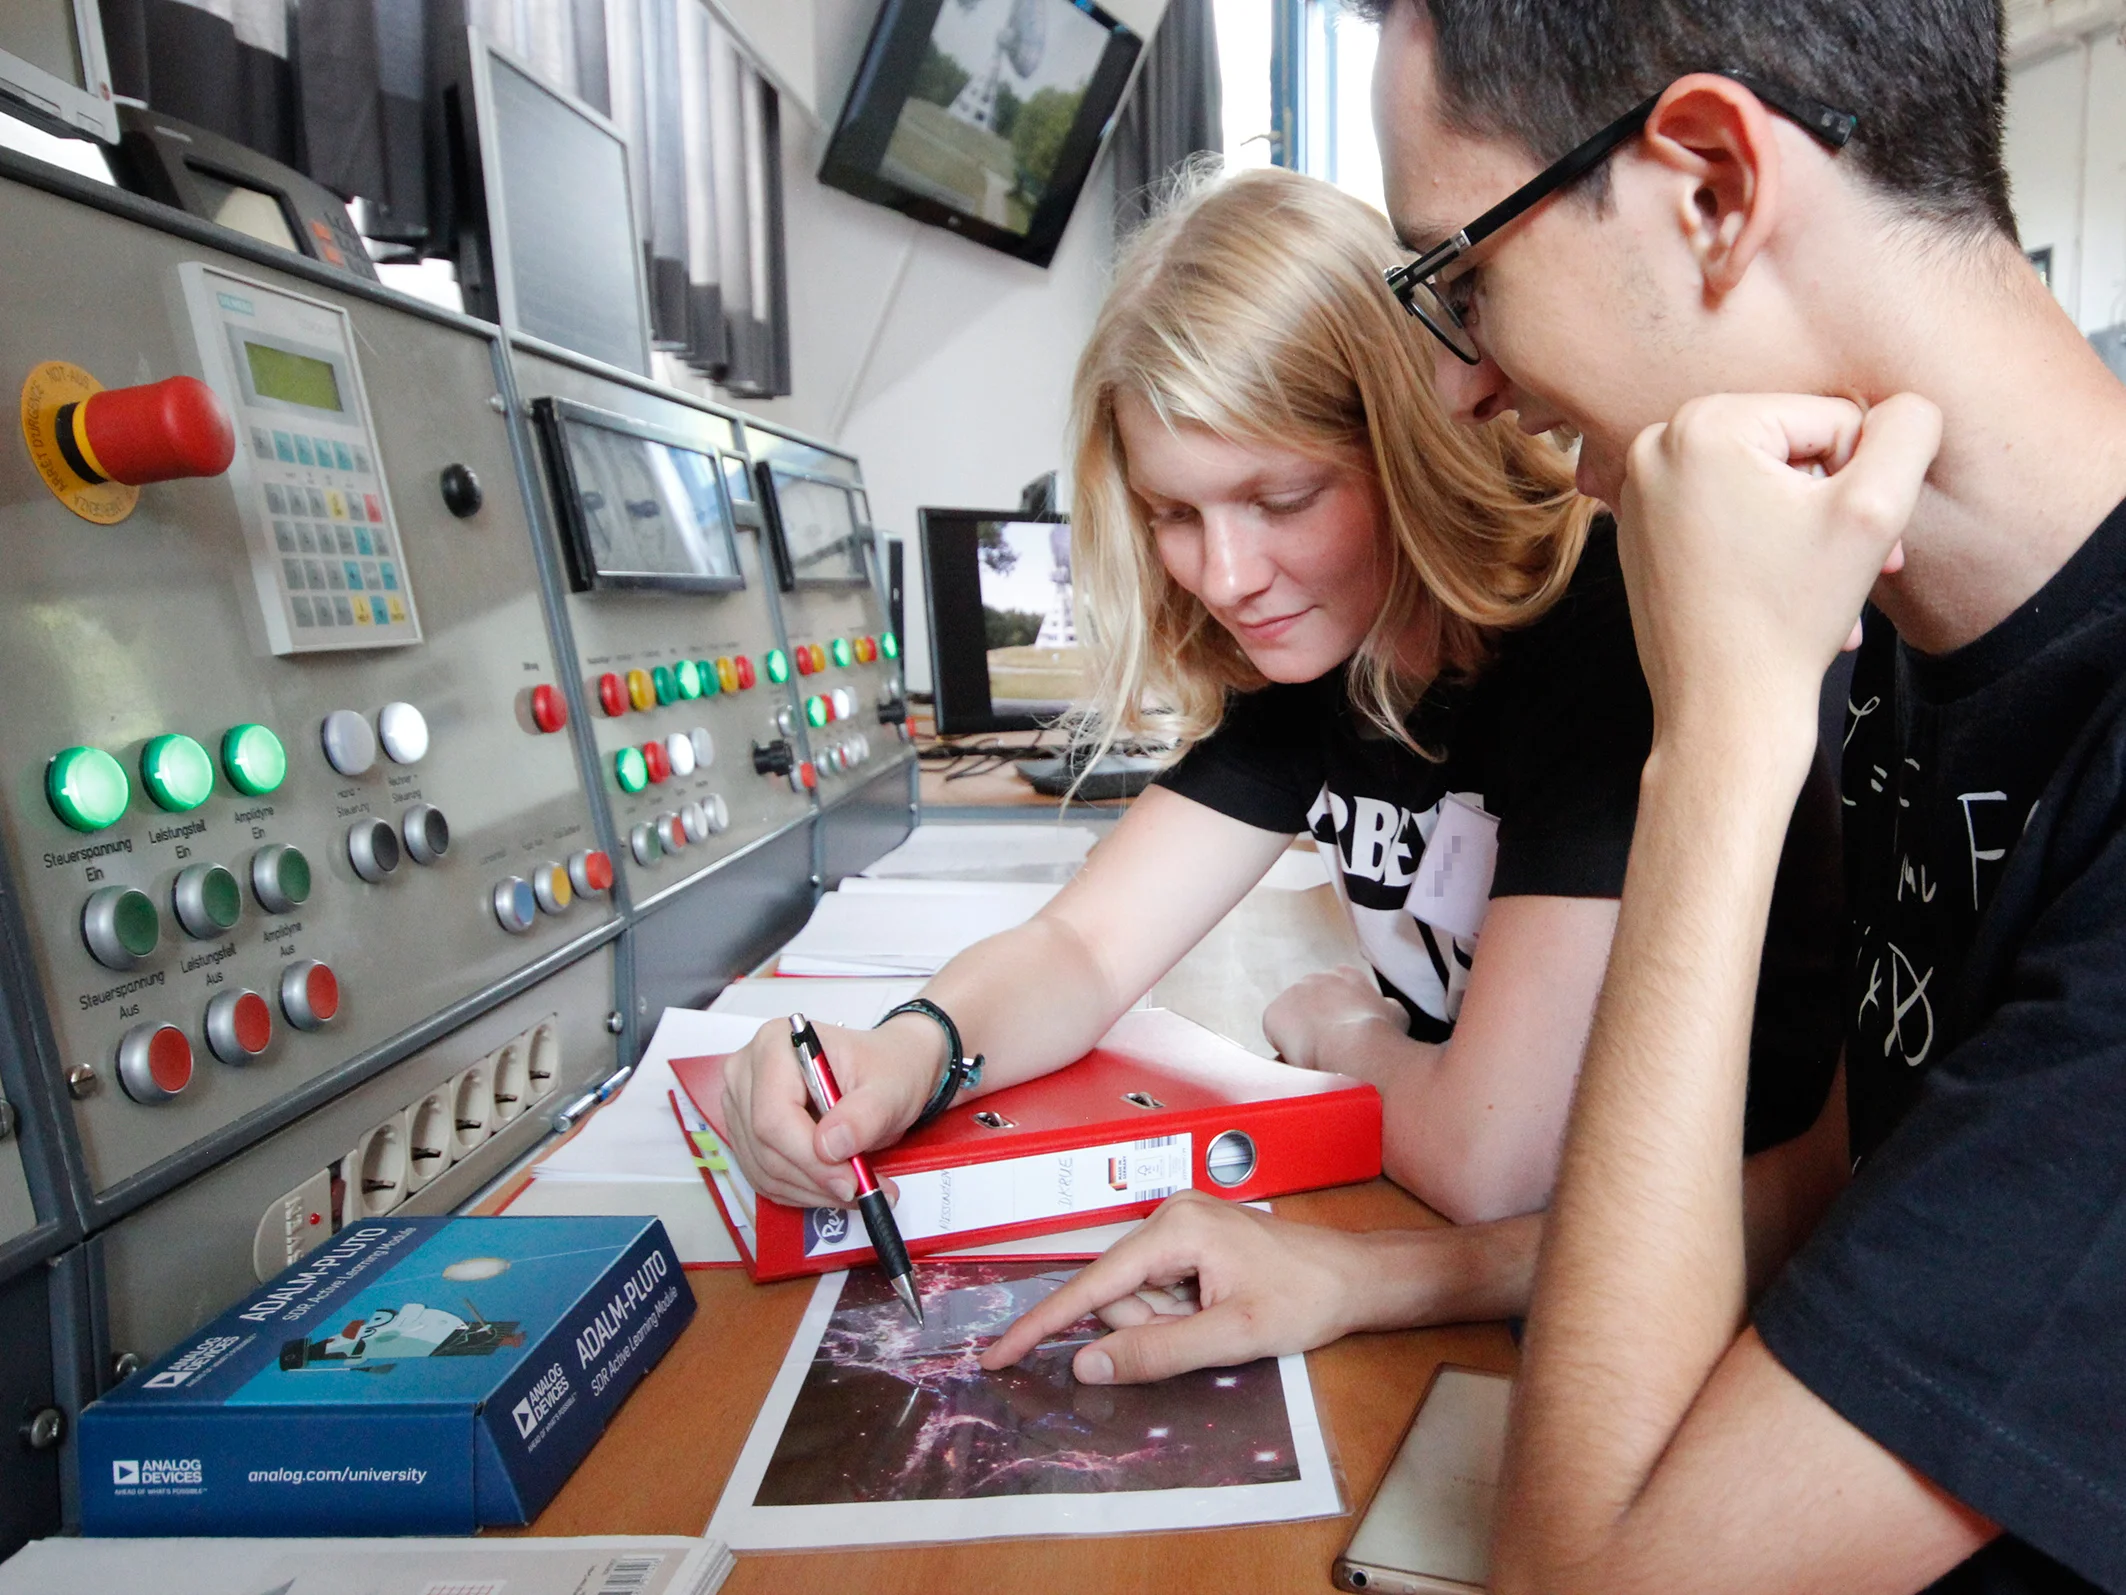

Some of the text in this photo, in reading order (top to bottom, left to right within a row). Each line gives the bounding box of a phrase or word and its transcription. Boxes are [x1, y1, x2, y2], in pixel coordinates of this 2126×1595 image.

[148, 819, 207, 844] Leistungsteil
[252, 827, 265, 839] Ein
[43, 837, 132, 869] Steuerspannung
[176, 845, 191, 859] Ein
[86, 866, 104, 882] Ein
[181, 943, 236, 974] Leistungsteil
[280, 944, 295, 958] Aus
[79, 970, 165, 1010] Steuerspannung
[206, 971, 223, 985] Aus
[120, 1004, 140, 1020] Aus
[239, 1227, 388, 1321] ADALM-PLUTO
[282, 1227, 417, 1321] SDR Active Learning Module
[575, 1250, 668, 1370] ADALM-PLUTO
[167, 1336, 222, 1370] ANALOG
[182, 1336, 240, 1371] DEVICES
[591, 1286, 678, 1397] SDR Active Learning Module
[529, 1363, 563, 1406] ANALOG
[534, 1376, 569, 1421] DEVICES
[142, 1459, 202, 1472] ANALOG
[142, 1471, 202, 1484] DEVICES
[248, 1466, 428, 1484] analog.com/university
